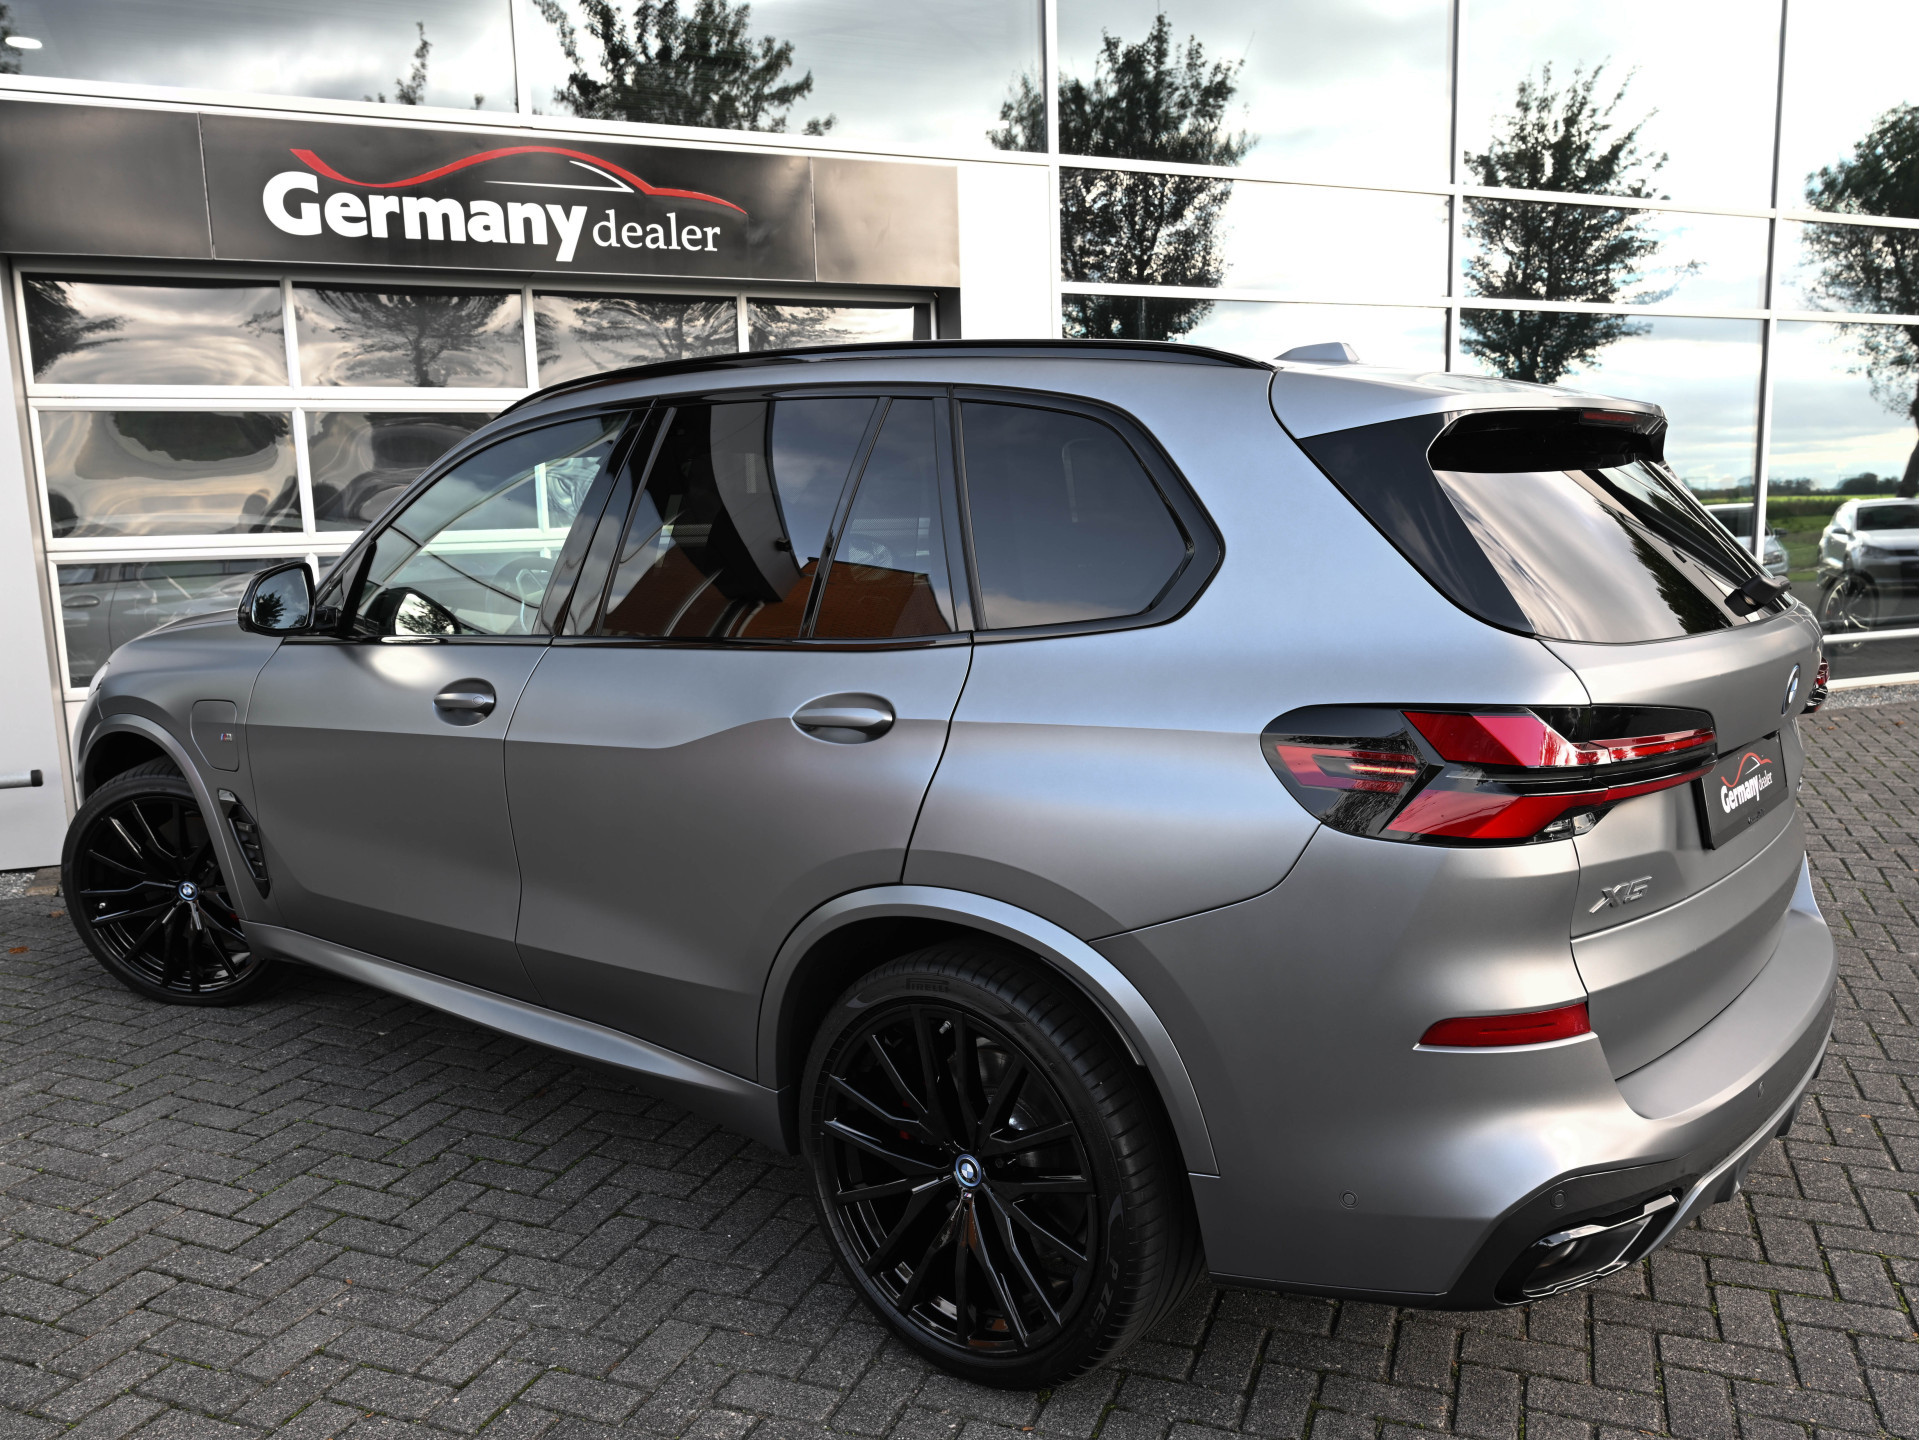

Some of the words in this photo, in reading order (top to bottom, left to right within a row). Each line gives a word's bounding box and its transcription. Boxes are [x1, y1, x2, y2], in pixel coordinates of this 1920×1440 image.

[262, 170, 588, 262] Germany
[592, 209, 721, 252] dealer
[1720, 775, 1760, 813] Germany
[1758, 770, 1773, 791] dealer
[1588, 875, 1653, 914] X5
[906, 977, 950, 993] PIRELLI
